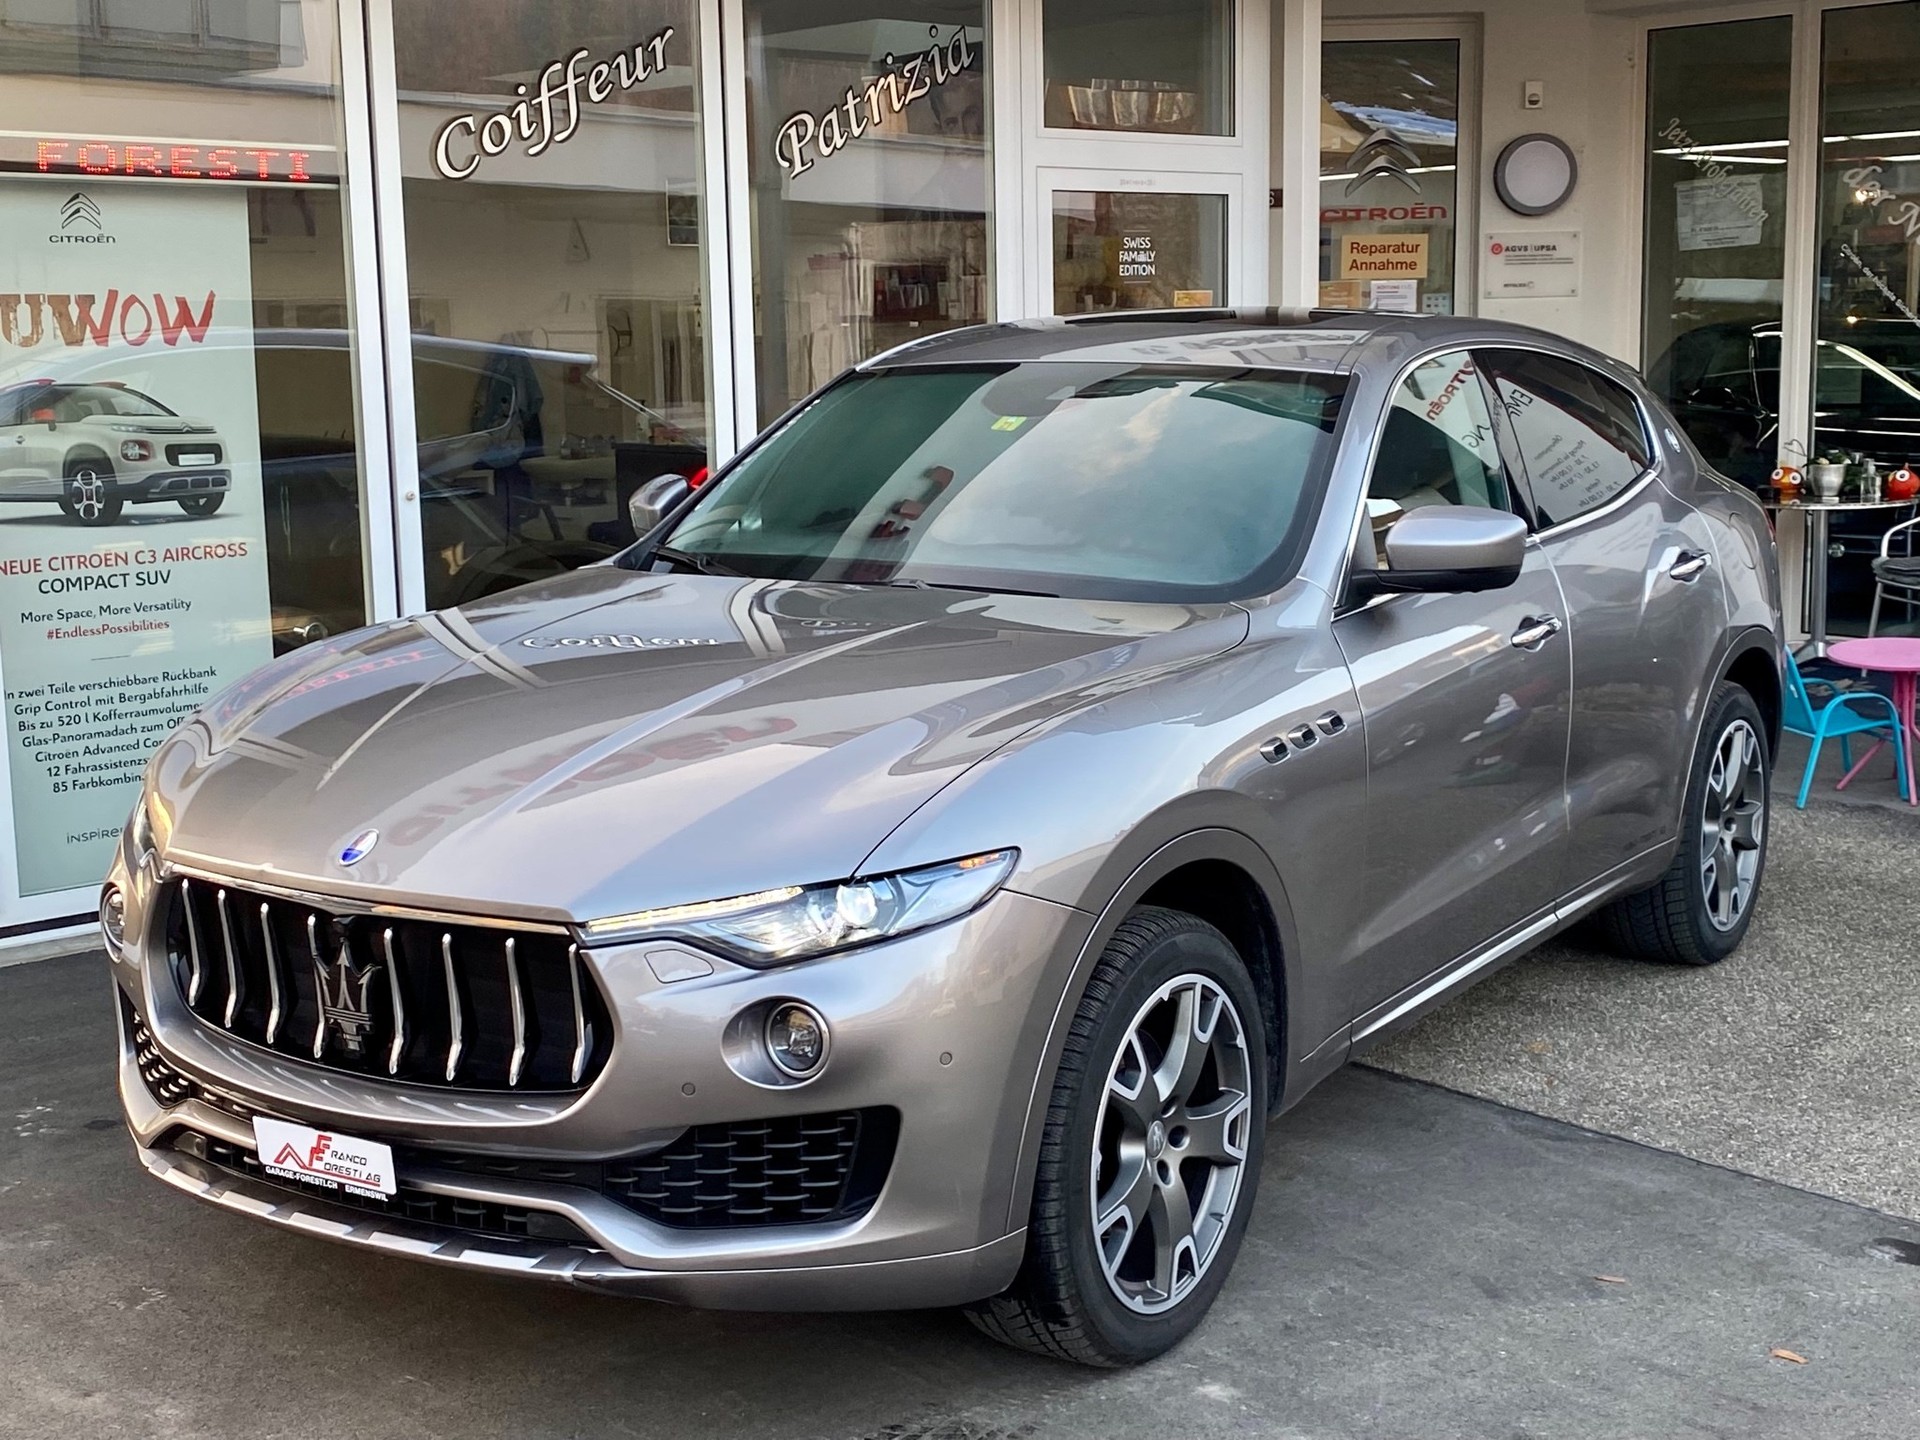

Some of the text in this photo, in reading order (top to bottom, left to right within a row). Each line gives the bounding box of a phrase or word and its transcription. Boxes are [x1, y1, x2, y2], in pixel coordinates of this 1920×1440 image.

[435, 24, 976, 181] Coiffeur Patrizia
[37, 141, 310, 180] FORESTI
[49, 233, 116, 244] CITROËN
[1123, 237, 1151, 249] SWISS
[1350, 242, 1421, 256] Reparatur
[1504, 244, 1557, 253] AGVS UPSA
[1119, 264, 1156, 276] EDITION
[1349, 259, 1418, 271] Annahme
[48, 549, 129, 572] CITROËN
[135, 549, 157, 565] C3
[163, 542, 248, 563] AIRCROSS
[38, 569, 171, 594] COMPACT SUV
[21, 598, 192, 623] More Space, More Versatility
[47, 620, 170, 640] #EndlessPossibilities
[18, 689, 45, 699] zwei
[47, 682, 76, 695] Teile
[79, 673, 159, 691] verschiebbare
[162, 666, 217, 683] Rückbank
[14, 683, 208, 717] Grip Control mit Bergabfahrhilfe
[18, 721, 36, 732] Bis
[40, 719, 53, 729] zu
[58, 714, 81, 727] 520
[22, 722, 137, 748] Glas-Panoramadach
[141, 723, 164, 734] zum
[35, 749, 79, 763] Citroën
[83, 739, 139, 757] Advanced
[47, 766, 60, 778] 12
[53, 781, 68, 793] 85
[366, 1172, 381, 1183] AG
